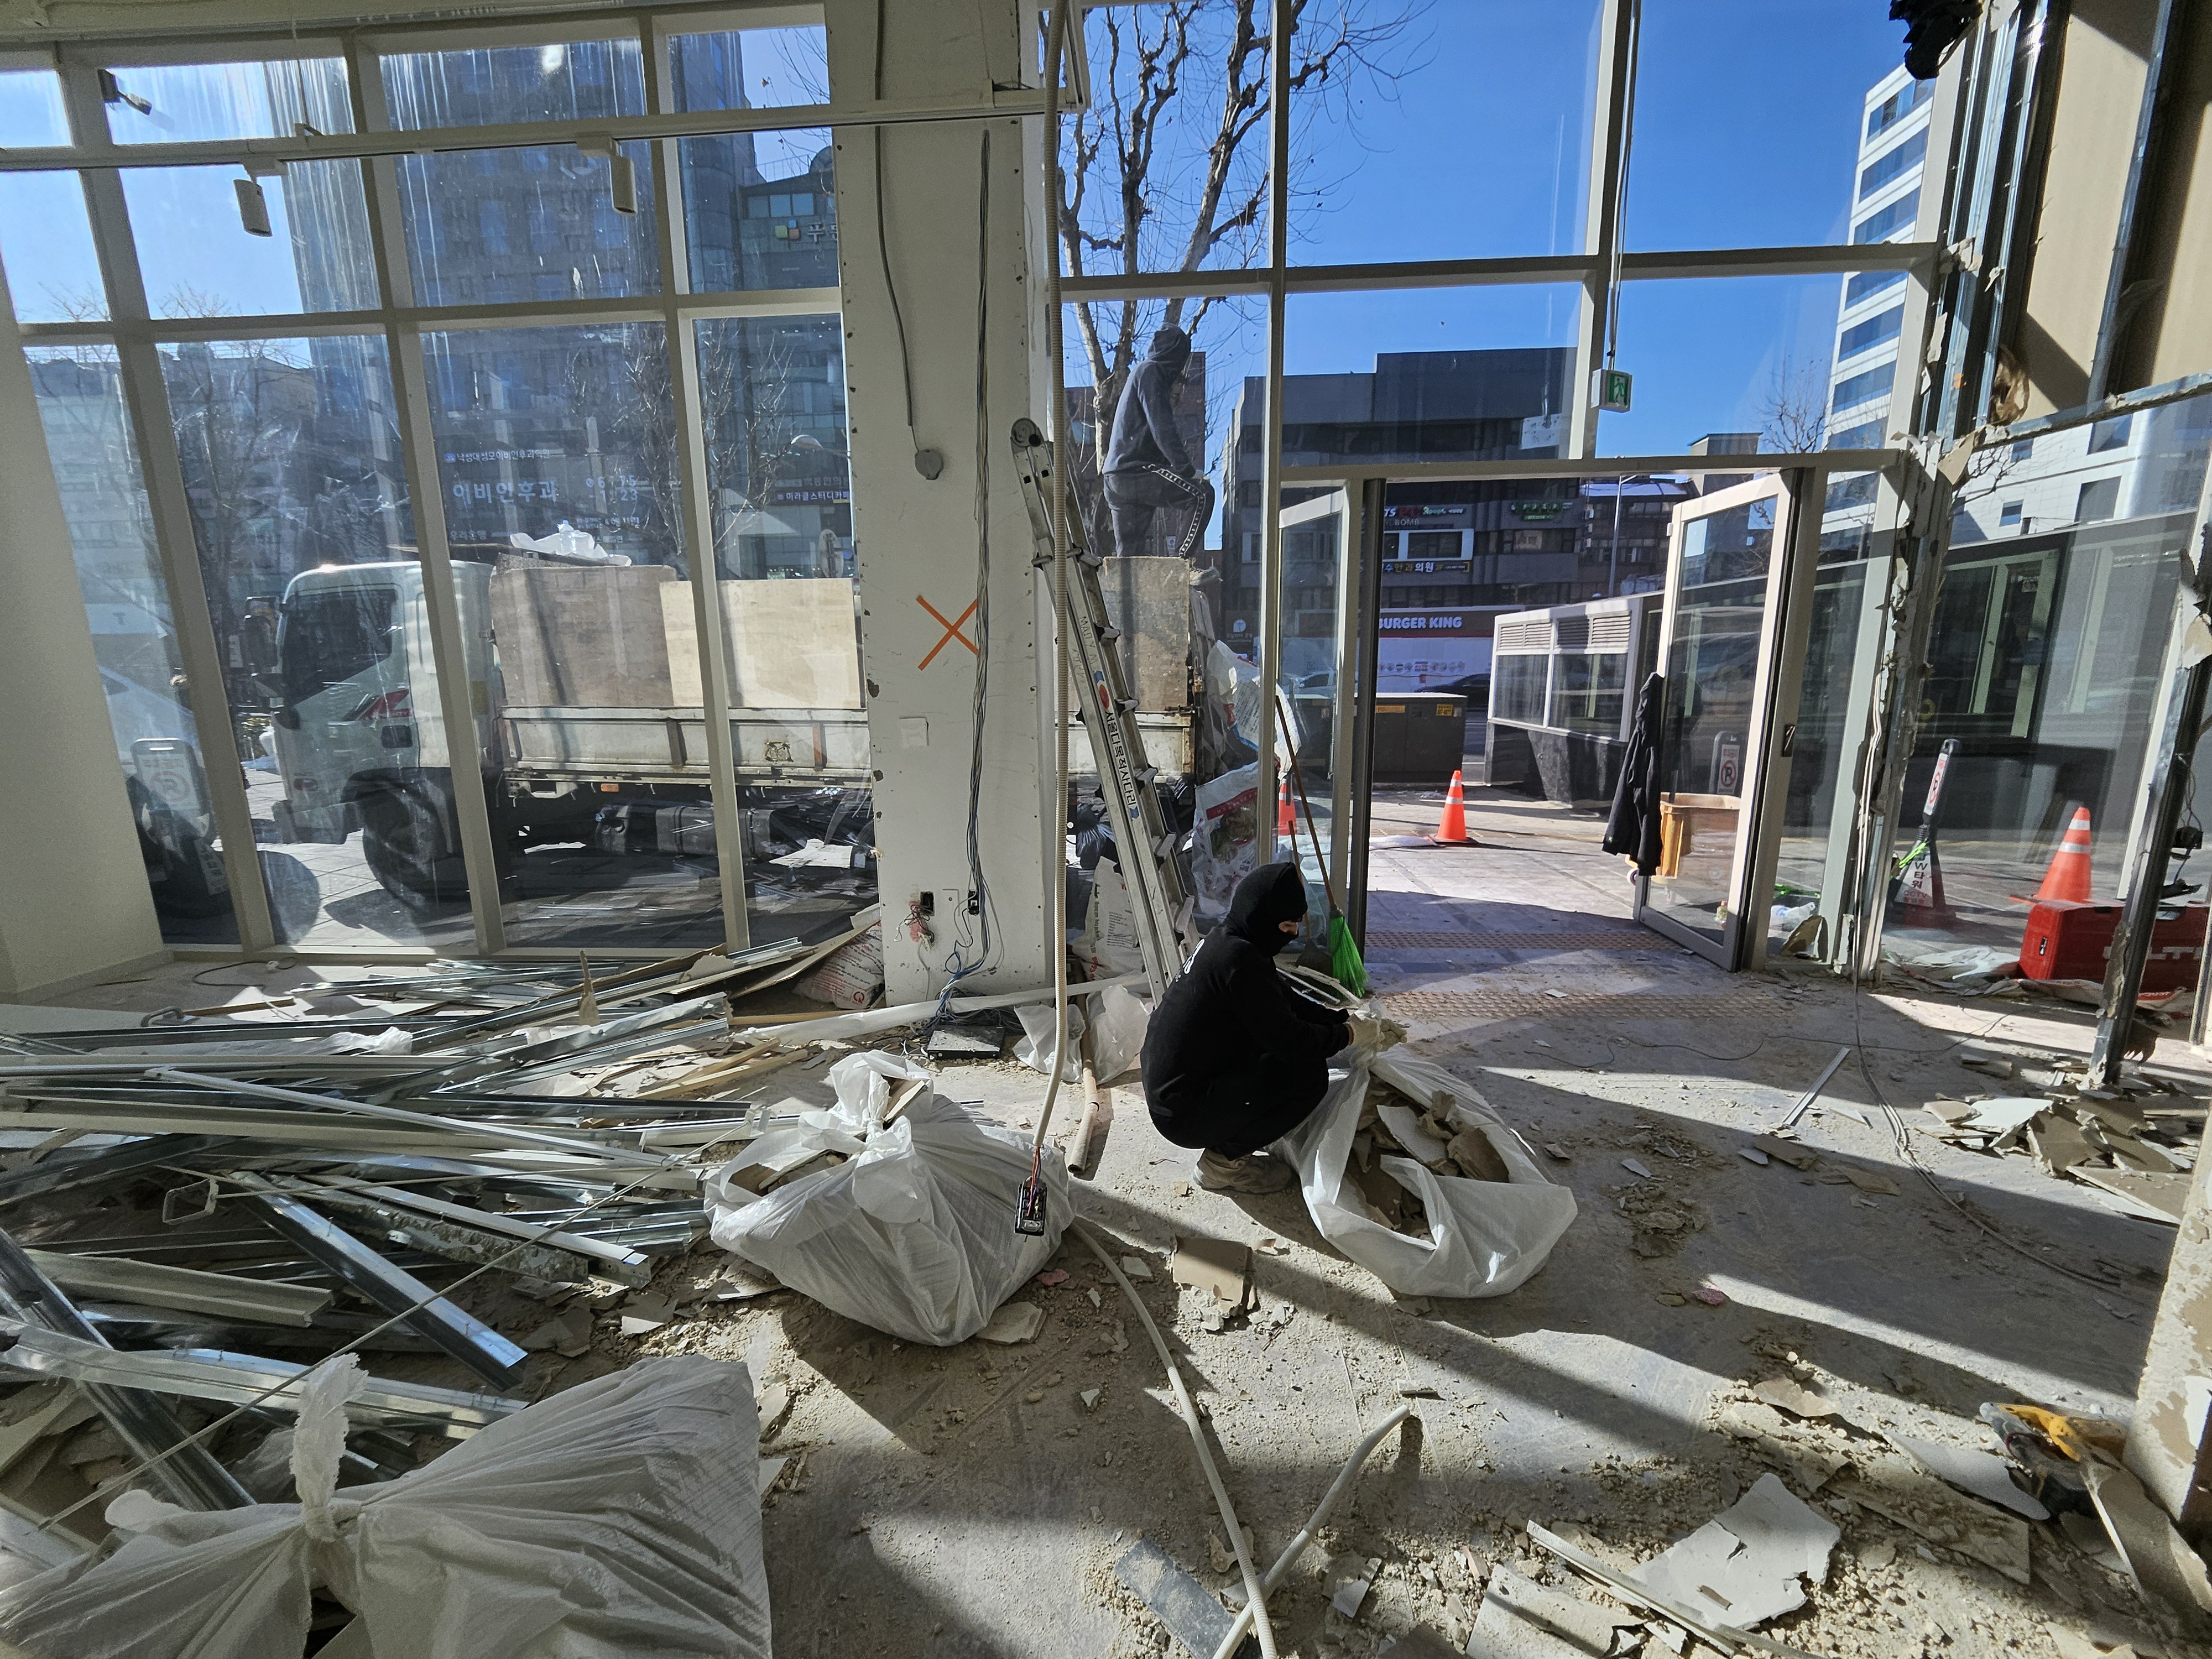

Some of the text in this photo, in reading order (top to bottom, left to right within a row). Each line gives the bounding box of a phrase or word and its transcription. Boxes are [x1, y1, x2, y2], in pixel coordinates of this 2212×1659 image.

[452, 478, 557, 505] 이비인후과
[1379, 616, 1463, 629] BURGER KING
[1105, 711, 1137, 806] 서울다목적사다리
[1904, 889, 1927, 898] CCTV
